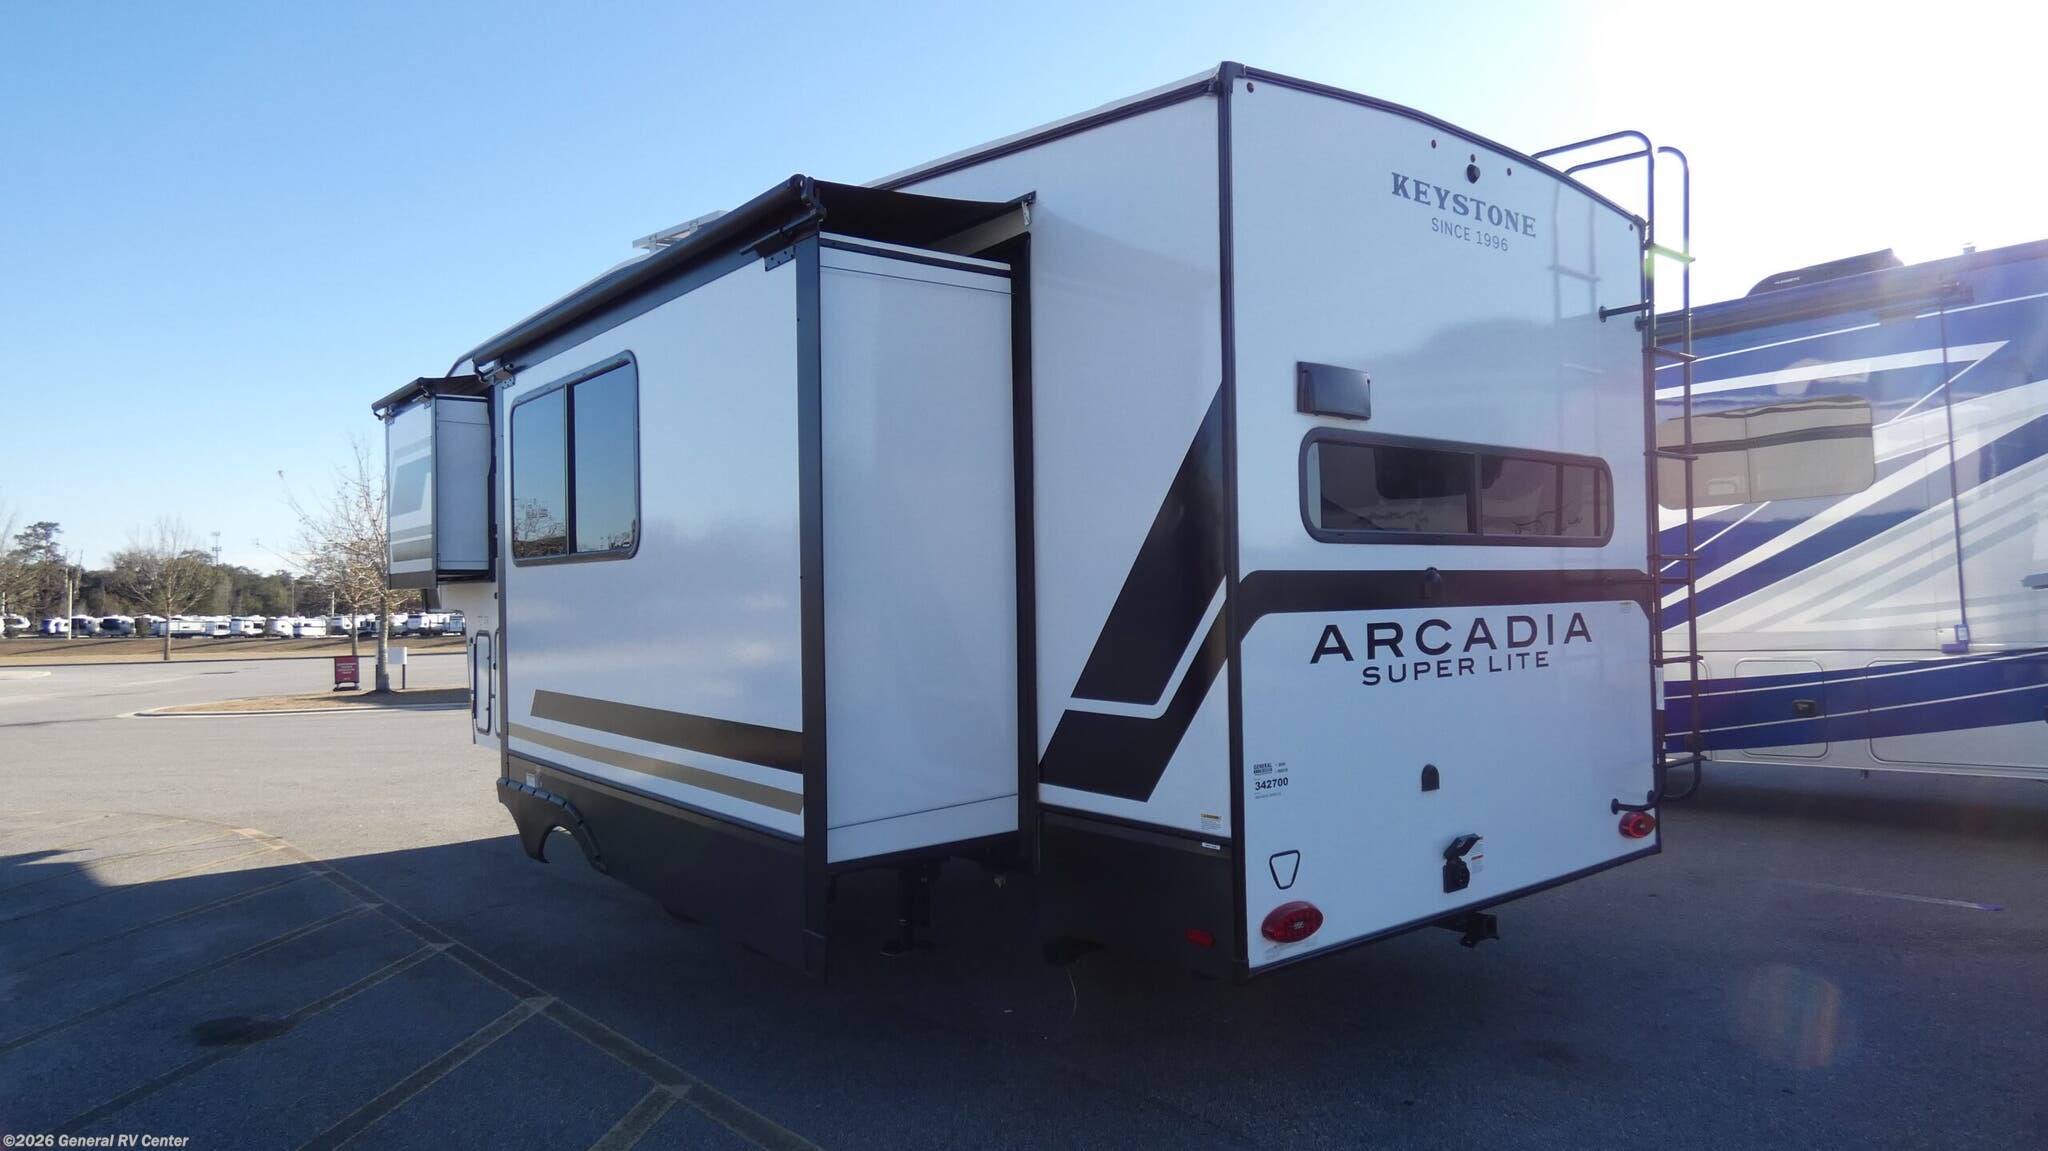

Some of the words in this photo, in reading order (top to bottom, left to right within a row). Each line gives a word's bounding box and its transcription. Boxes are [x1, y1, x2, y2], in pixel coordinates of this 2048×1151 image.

[1391, 172, 1537, 238] KEYSTONE
[1431, 217, 1471, 241] SINCE
[1476, 231, 1509, 251] 1996
[1310, 612, 1592, 664] ARCADIA
[1362, 657, 1475, 686] SUPER
[1489, 651, 1549, 673] LITE
[1255, 777, 1289, 791] 342700
